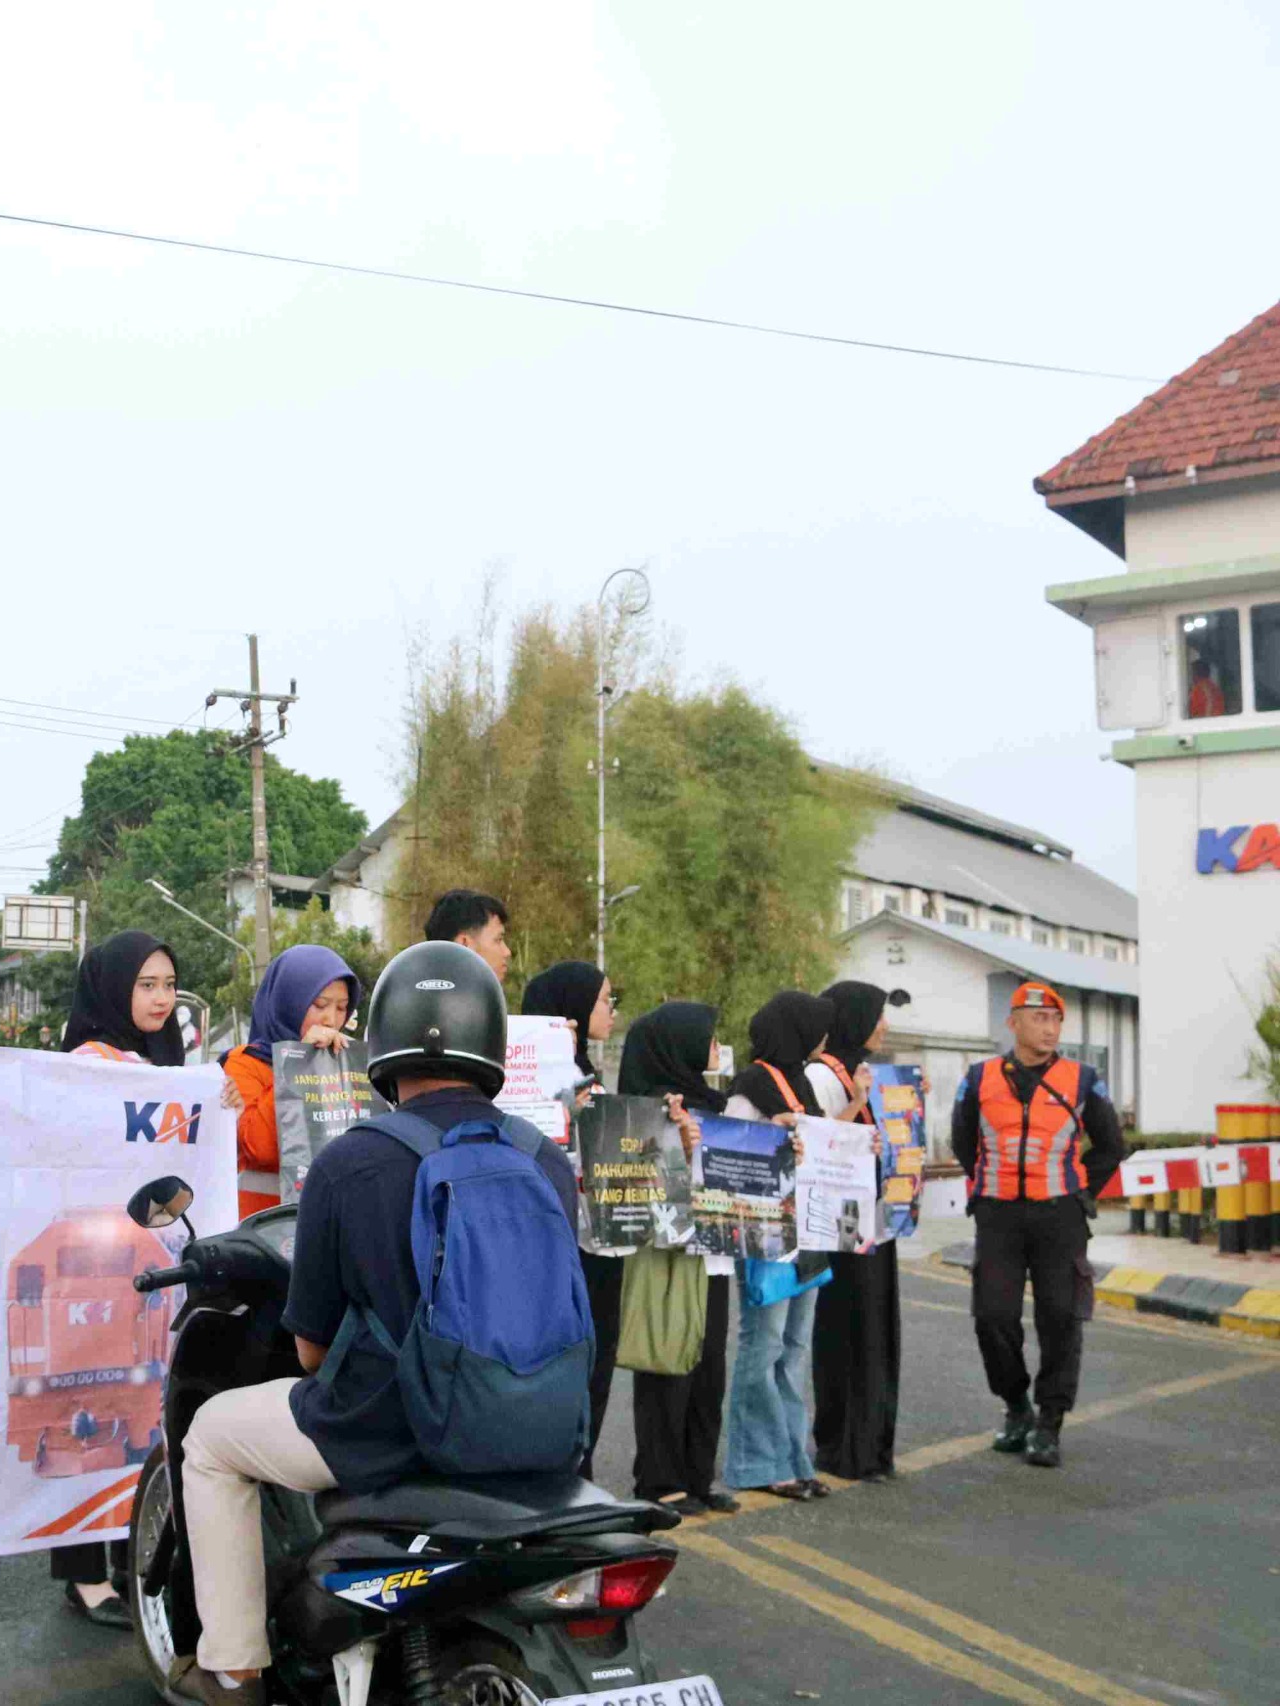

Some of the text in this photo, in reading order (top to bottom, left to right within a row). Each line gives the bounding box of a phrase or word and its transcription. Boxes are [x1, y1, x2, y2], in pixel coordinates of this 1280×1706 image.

[505, 1045, 536, 1060] OP!!!
[123, 1101, 202, 1144] KAI
[313, 1110, 357, 1122] KERETA
[591, 1667, 634, 1680] HONDA
